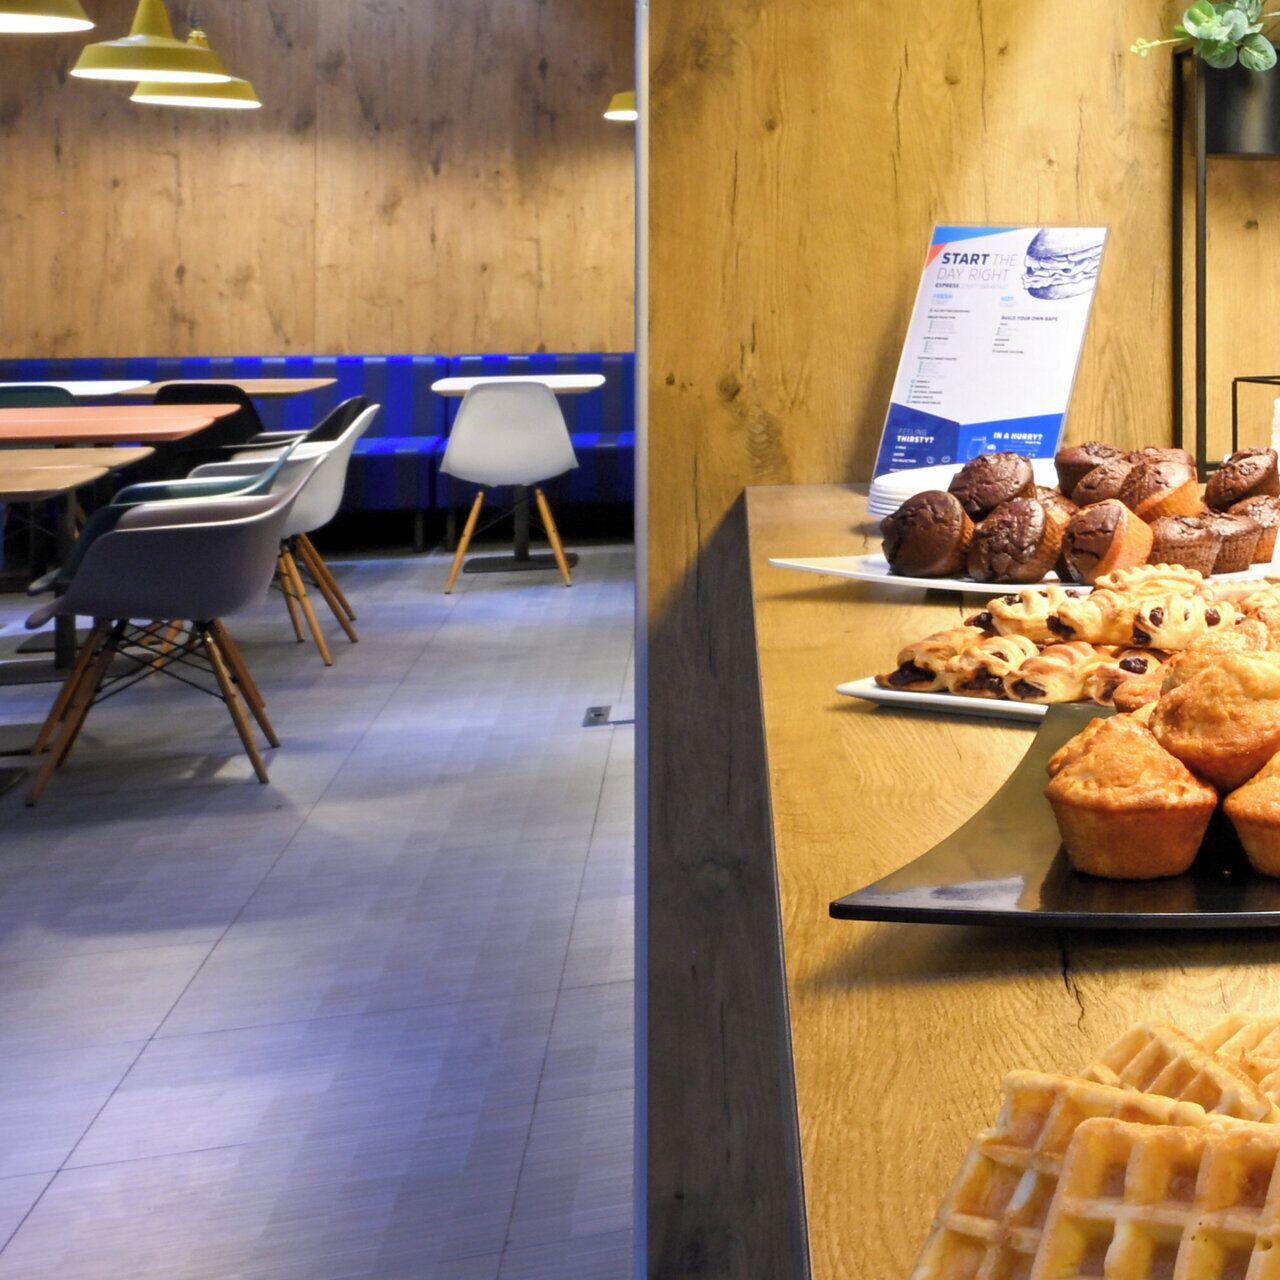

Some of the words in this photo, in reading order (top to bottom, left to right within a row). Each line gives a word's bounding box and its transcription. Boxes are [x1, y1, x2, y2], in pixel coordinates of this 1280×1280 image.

[941, 252, 990, 265] START
[993, 253, 1019, 267] THE
[936, 267, 963, 280] DAY
[968, 268, 1010, 281] RIGHT
[897, 435, 935, 444] THIRSTY?
[1003, 432, 1010, 440] A
[1010, 432, 1043, 441] HURRY?
